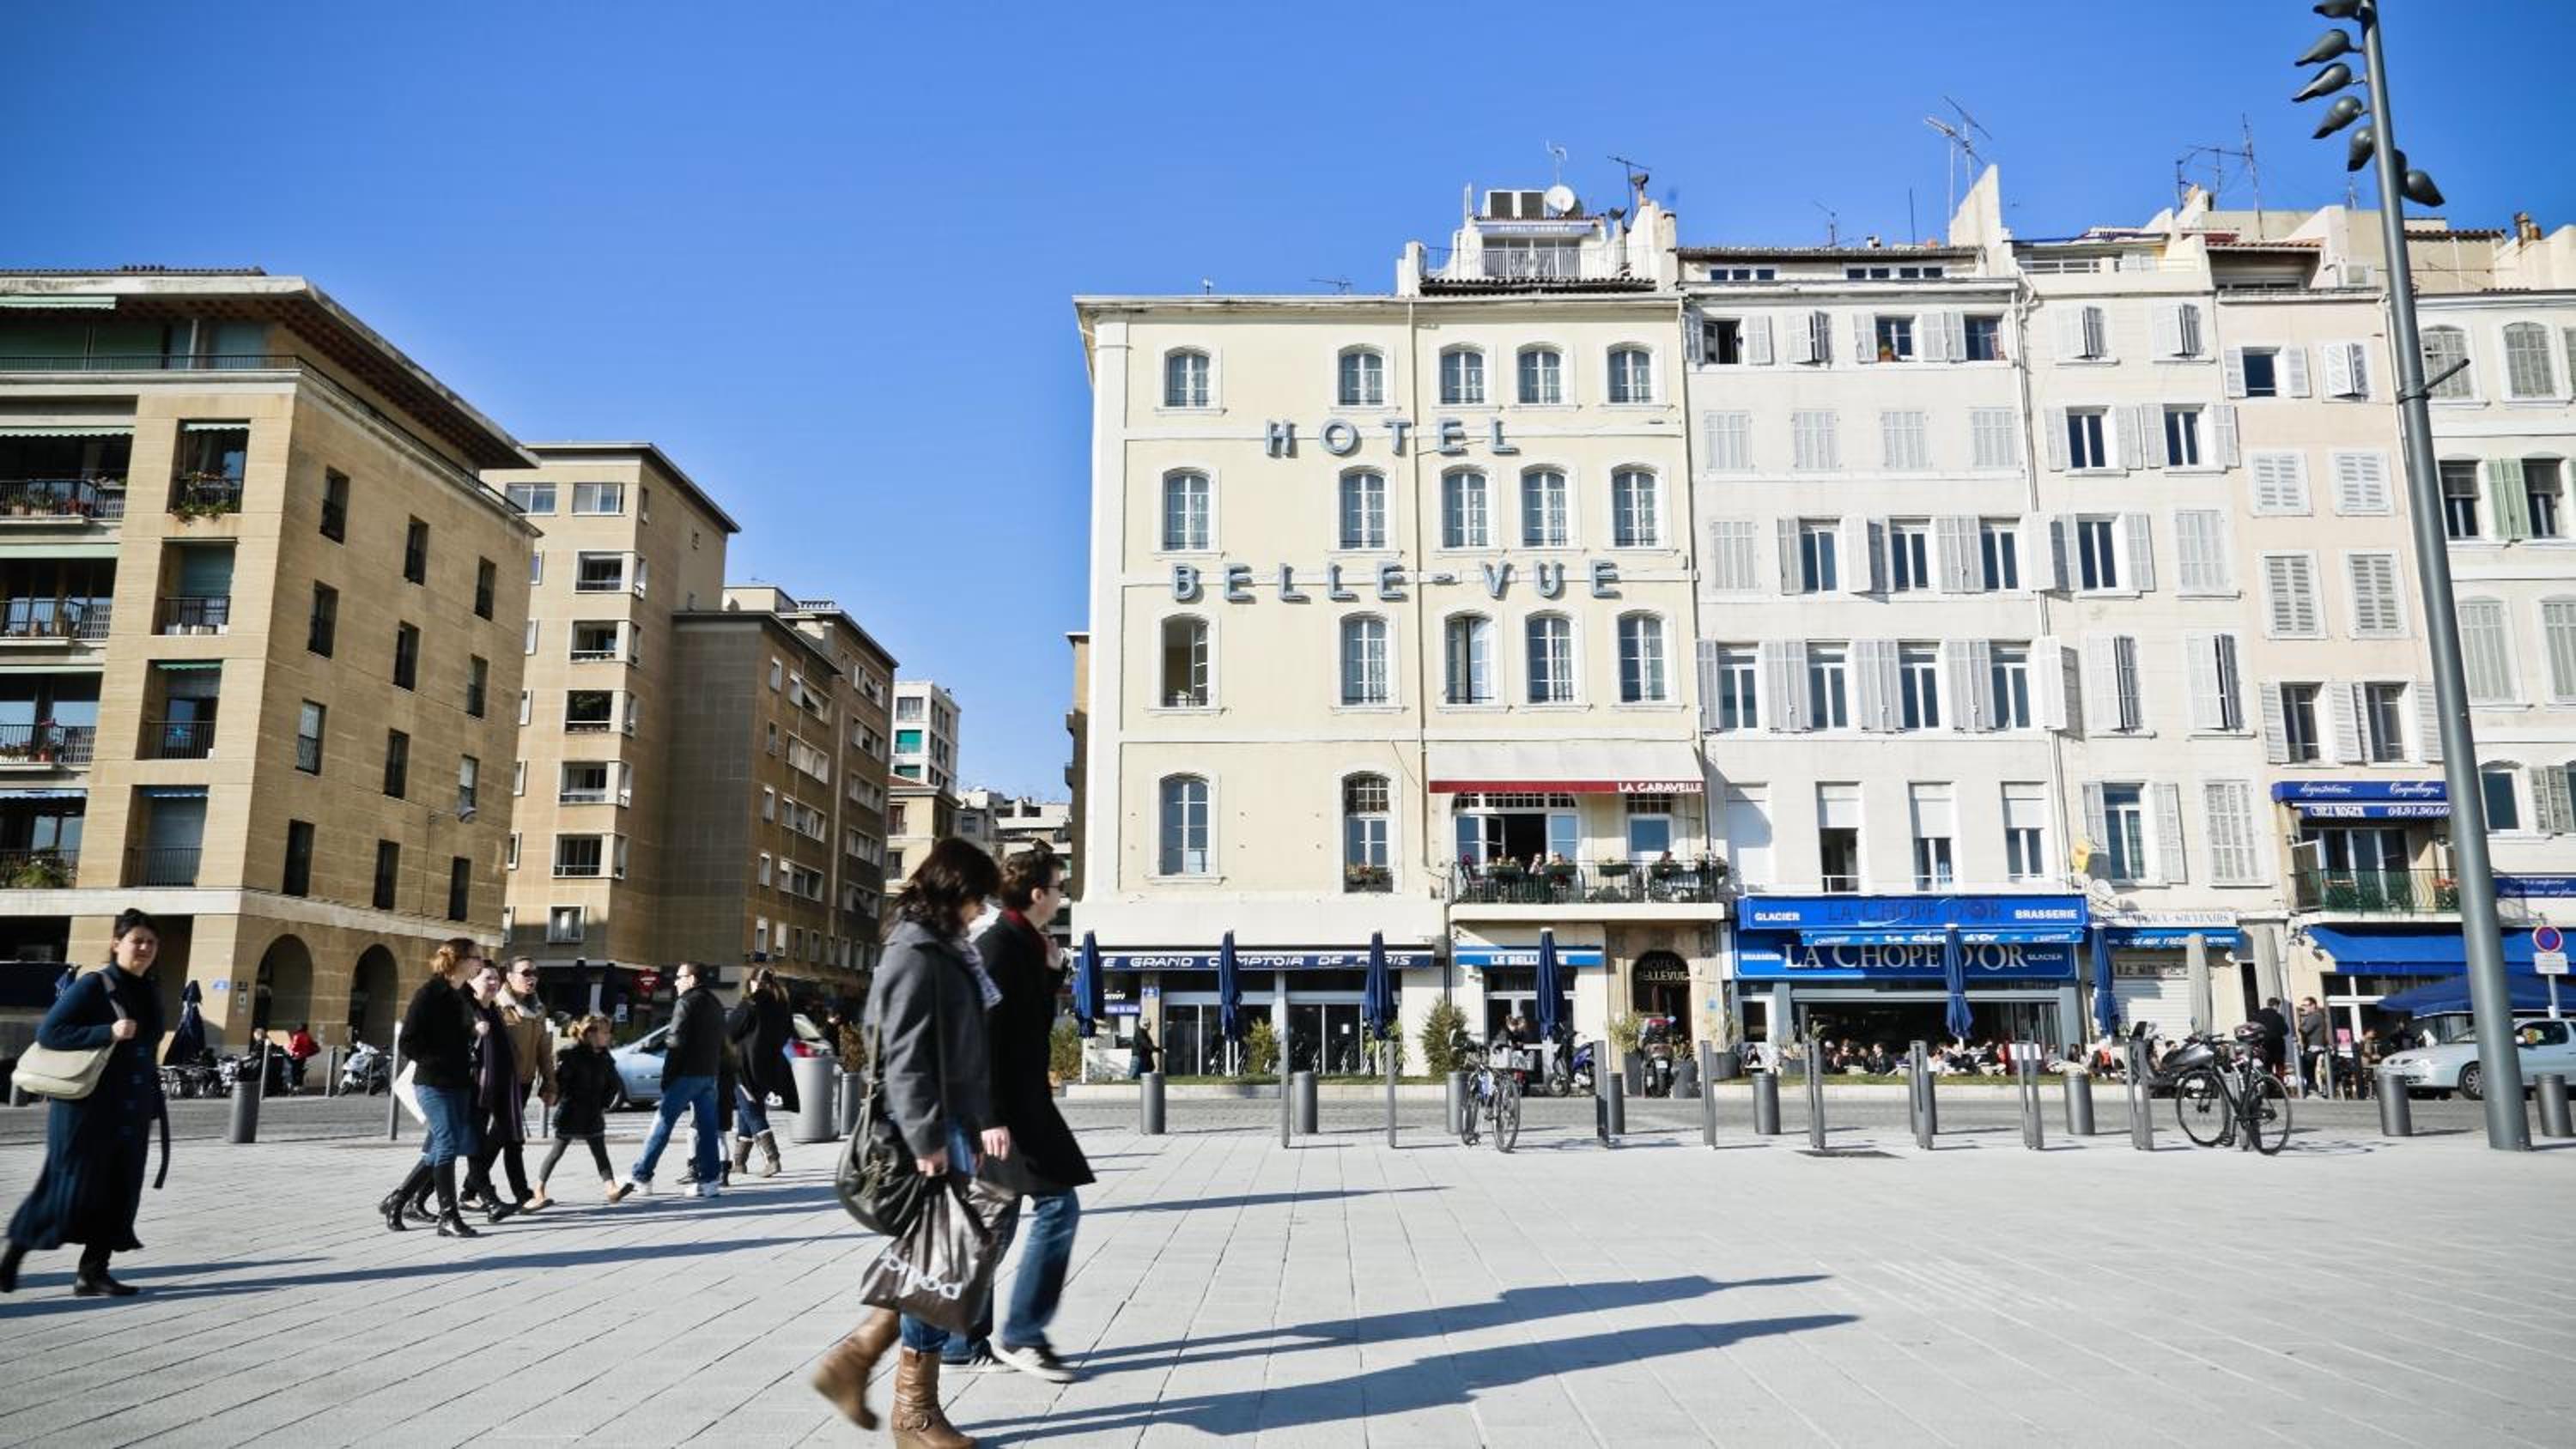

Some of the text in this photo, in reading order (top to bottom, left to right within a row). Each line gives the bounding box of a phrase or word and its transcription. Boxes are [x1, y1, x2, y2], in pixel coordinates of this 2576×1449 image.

[1265, 417, 1519, 456] HOTEL
[1618, 782, 1704, 791] LA CARAVELLE
[1754, 912, 1801, 921] GLACIER
[2014, 909, 2077, 919] BRASSERIE
[1911, 931, 1947, 943] Chop
[1129, 957, 1194, 967] GRAND
[1208, 956, 1303, 967] CMPTOIR
[1318, 955, 1344, 966] DE
[1357, 955, 1412, 966] PRIS
[1491, 955, 1506, 966] LE
[1783, 944, 1825, 968] LA
[1832, 944, 1941, 968] CHOPE
